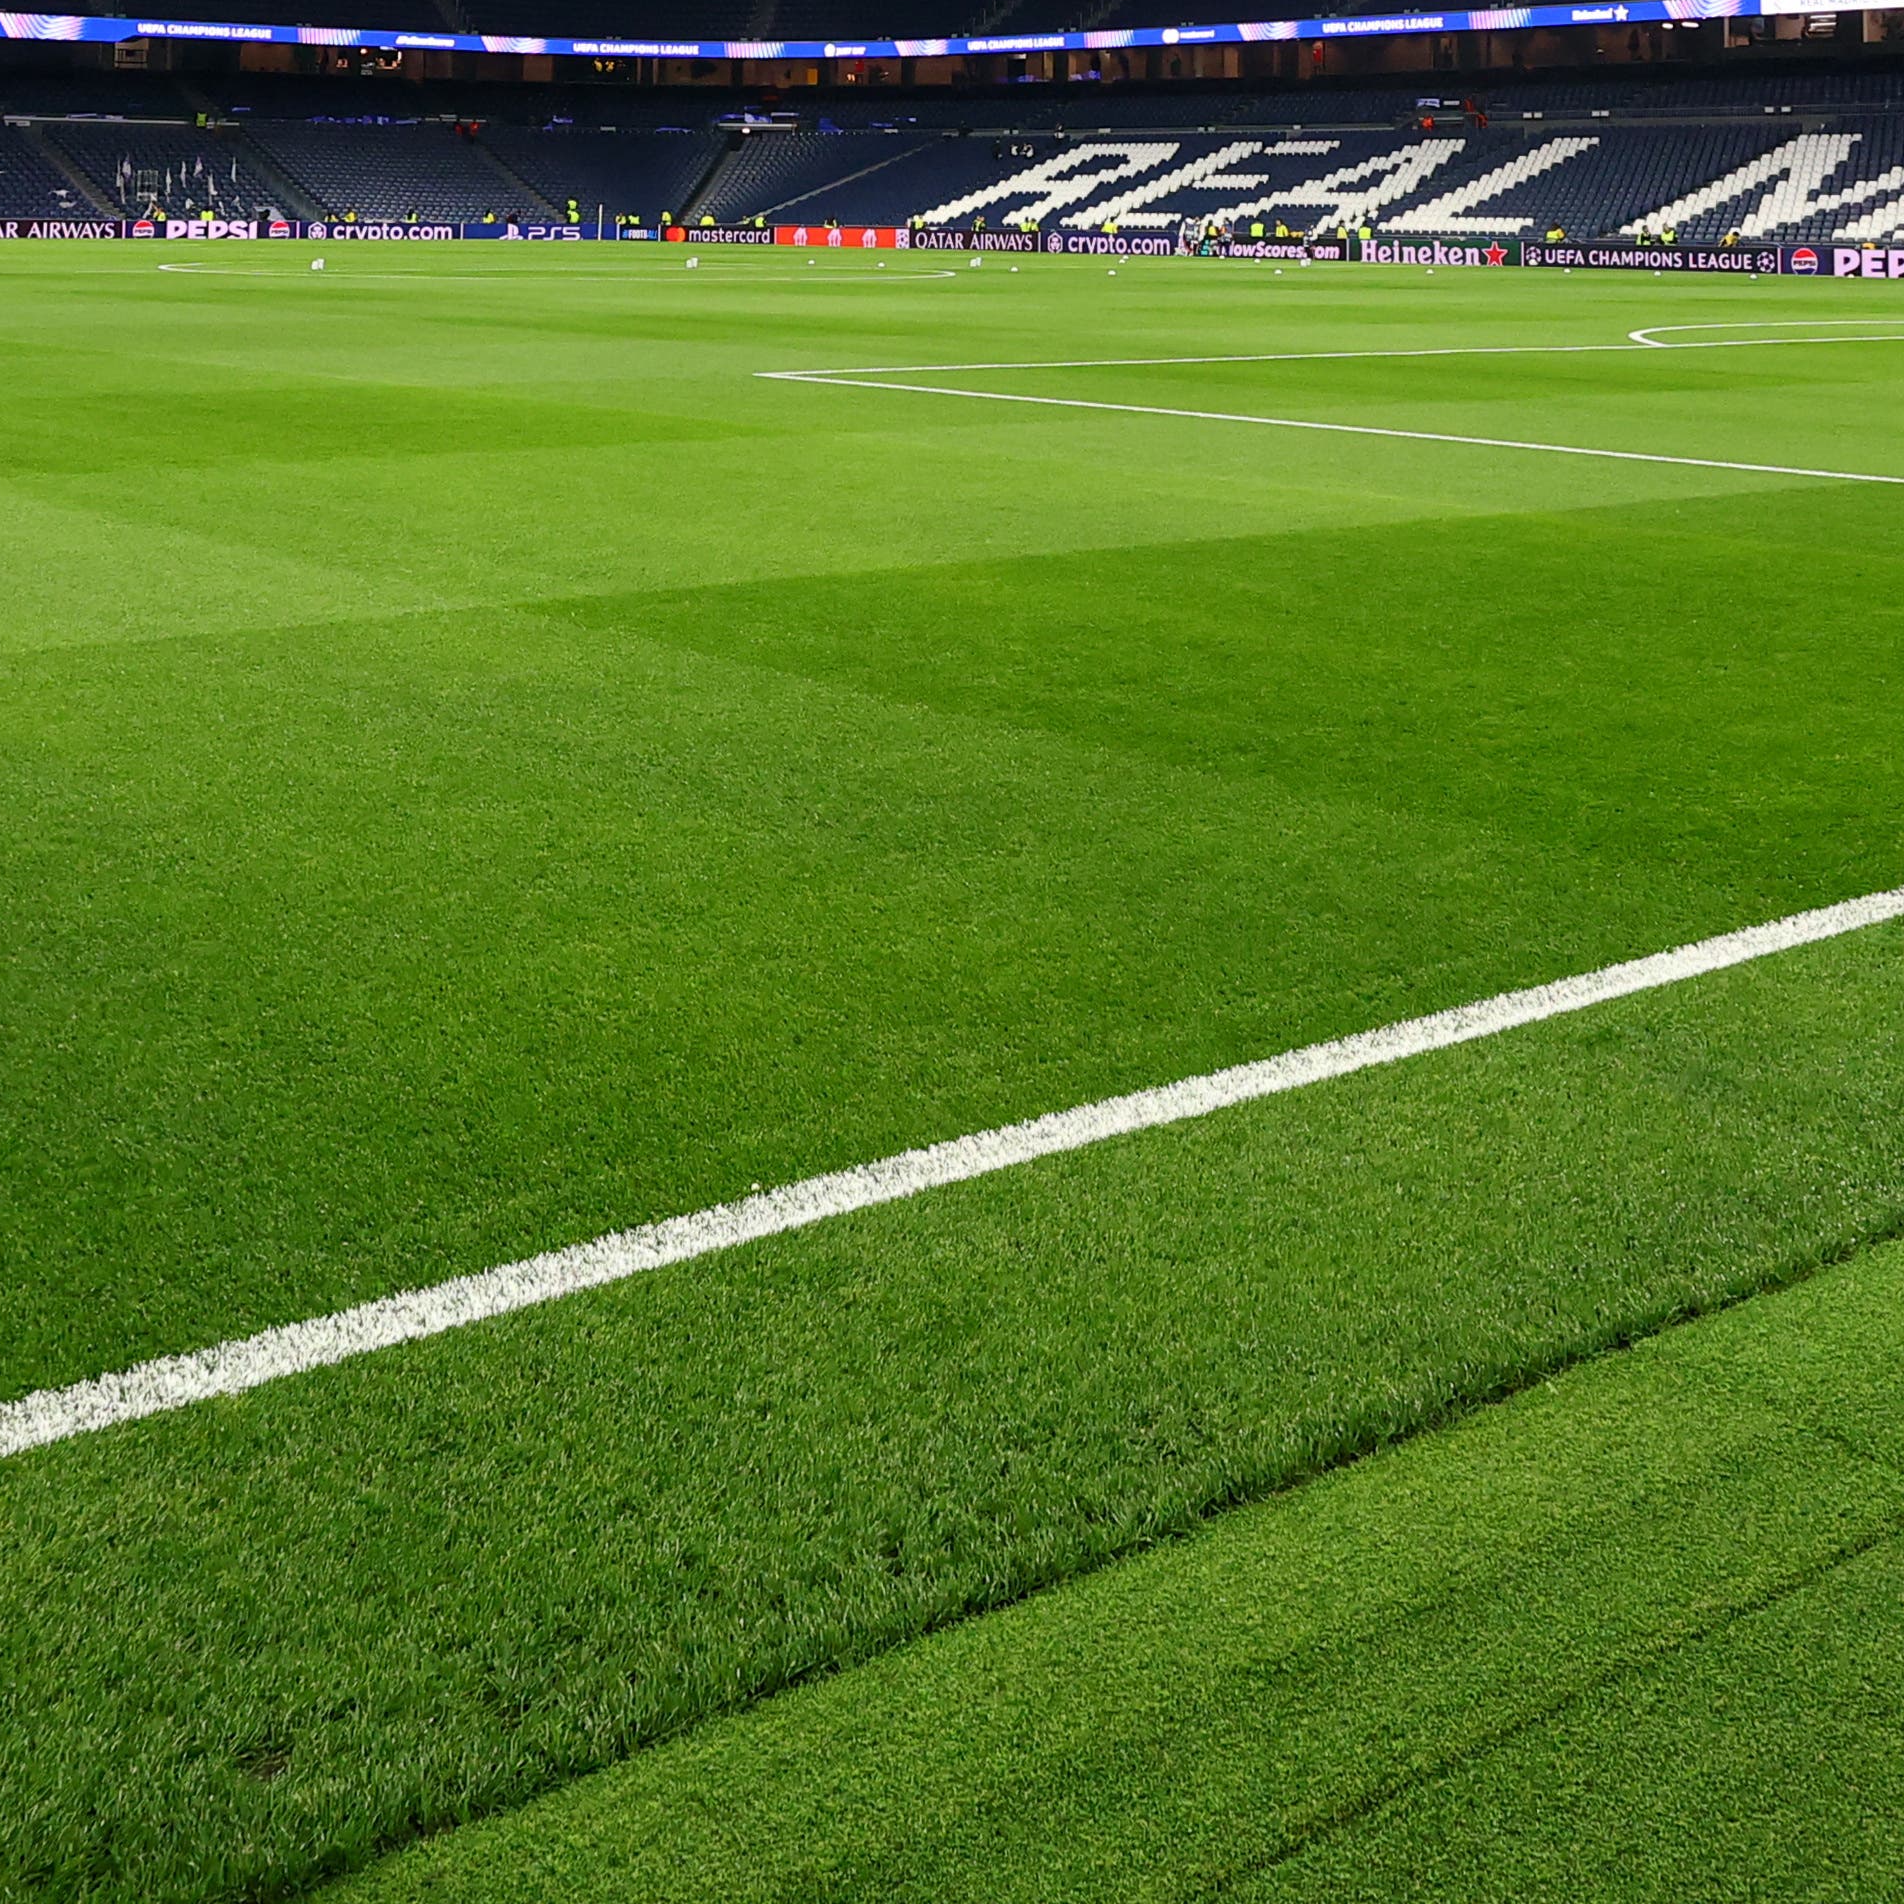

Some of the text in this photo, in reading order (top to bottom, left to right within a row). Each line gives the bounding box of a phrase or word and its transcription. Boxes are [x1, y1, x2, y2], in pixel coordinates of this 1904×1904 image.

[908, 136, 1600, 237] REAL
[27, 222, 115, 239] AIRWAYS
[166, 219, 258, 240] PEPSI
[332, 224, 453, 241] crypto.com
[527, 226, 581, 241] PS5
[688, 226, 771, 245] mastercard
[915, 228, 1033, 252] QATAR AIRWAYS
[1067, 234, 1170, 257] crypto.com
[1360, 238, 1481, 266] Heineken
[1544, 248, 1754, 270] UEFA CHAMPIONS LEAGUE
